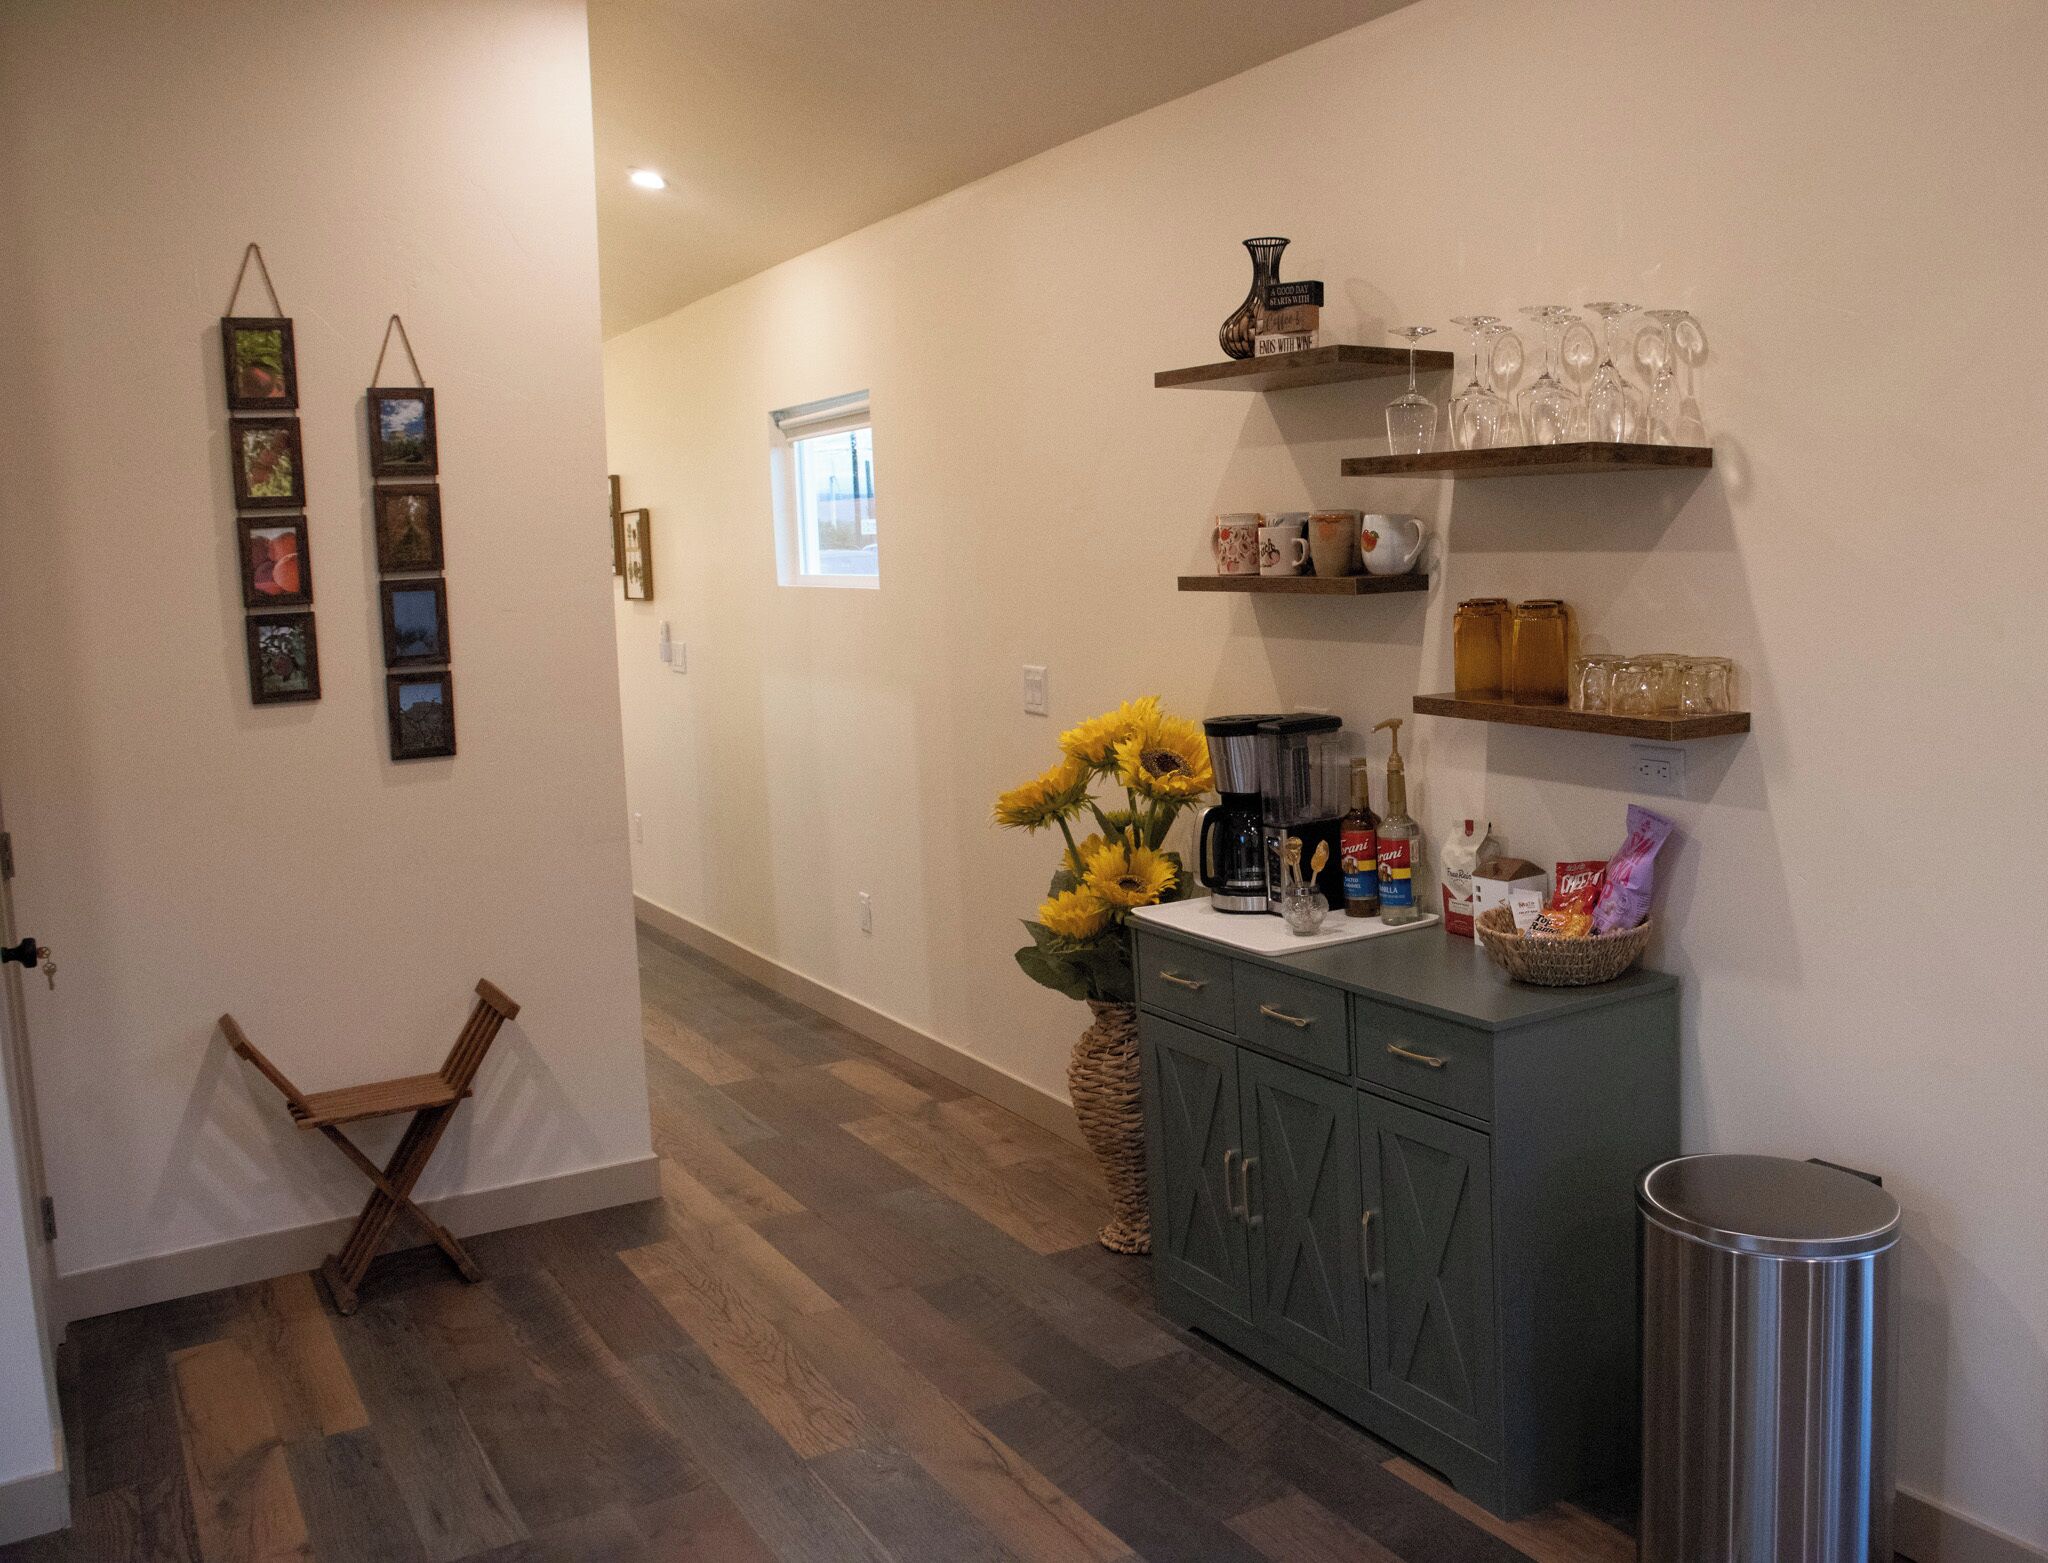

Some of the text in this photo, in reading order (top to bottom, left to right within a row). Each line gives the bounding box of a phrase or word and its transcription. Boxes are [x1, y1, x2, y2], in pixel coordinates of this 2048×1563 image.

[1276, 286, 1295, 295] GOOD
[1295, 284, 1309, 294] DAY
[1269, 294, 1310, 305] STARTS WITH
[1259, 335, 1312, 355] ENDS WITH WINE
[1535, 913, 1552, 927] Top
